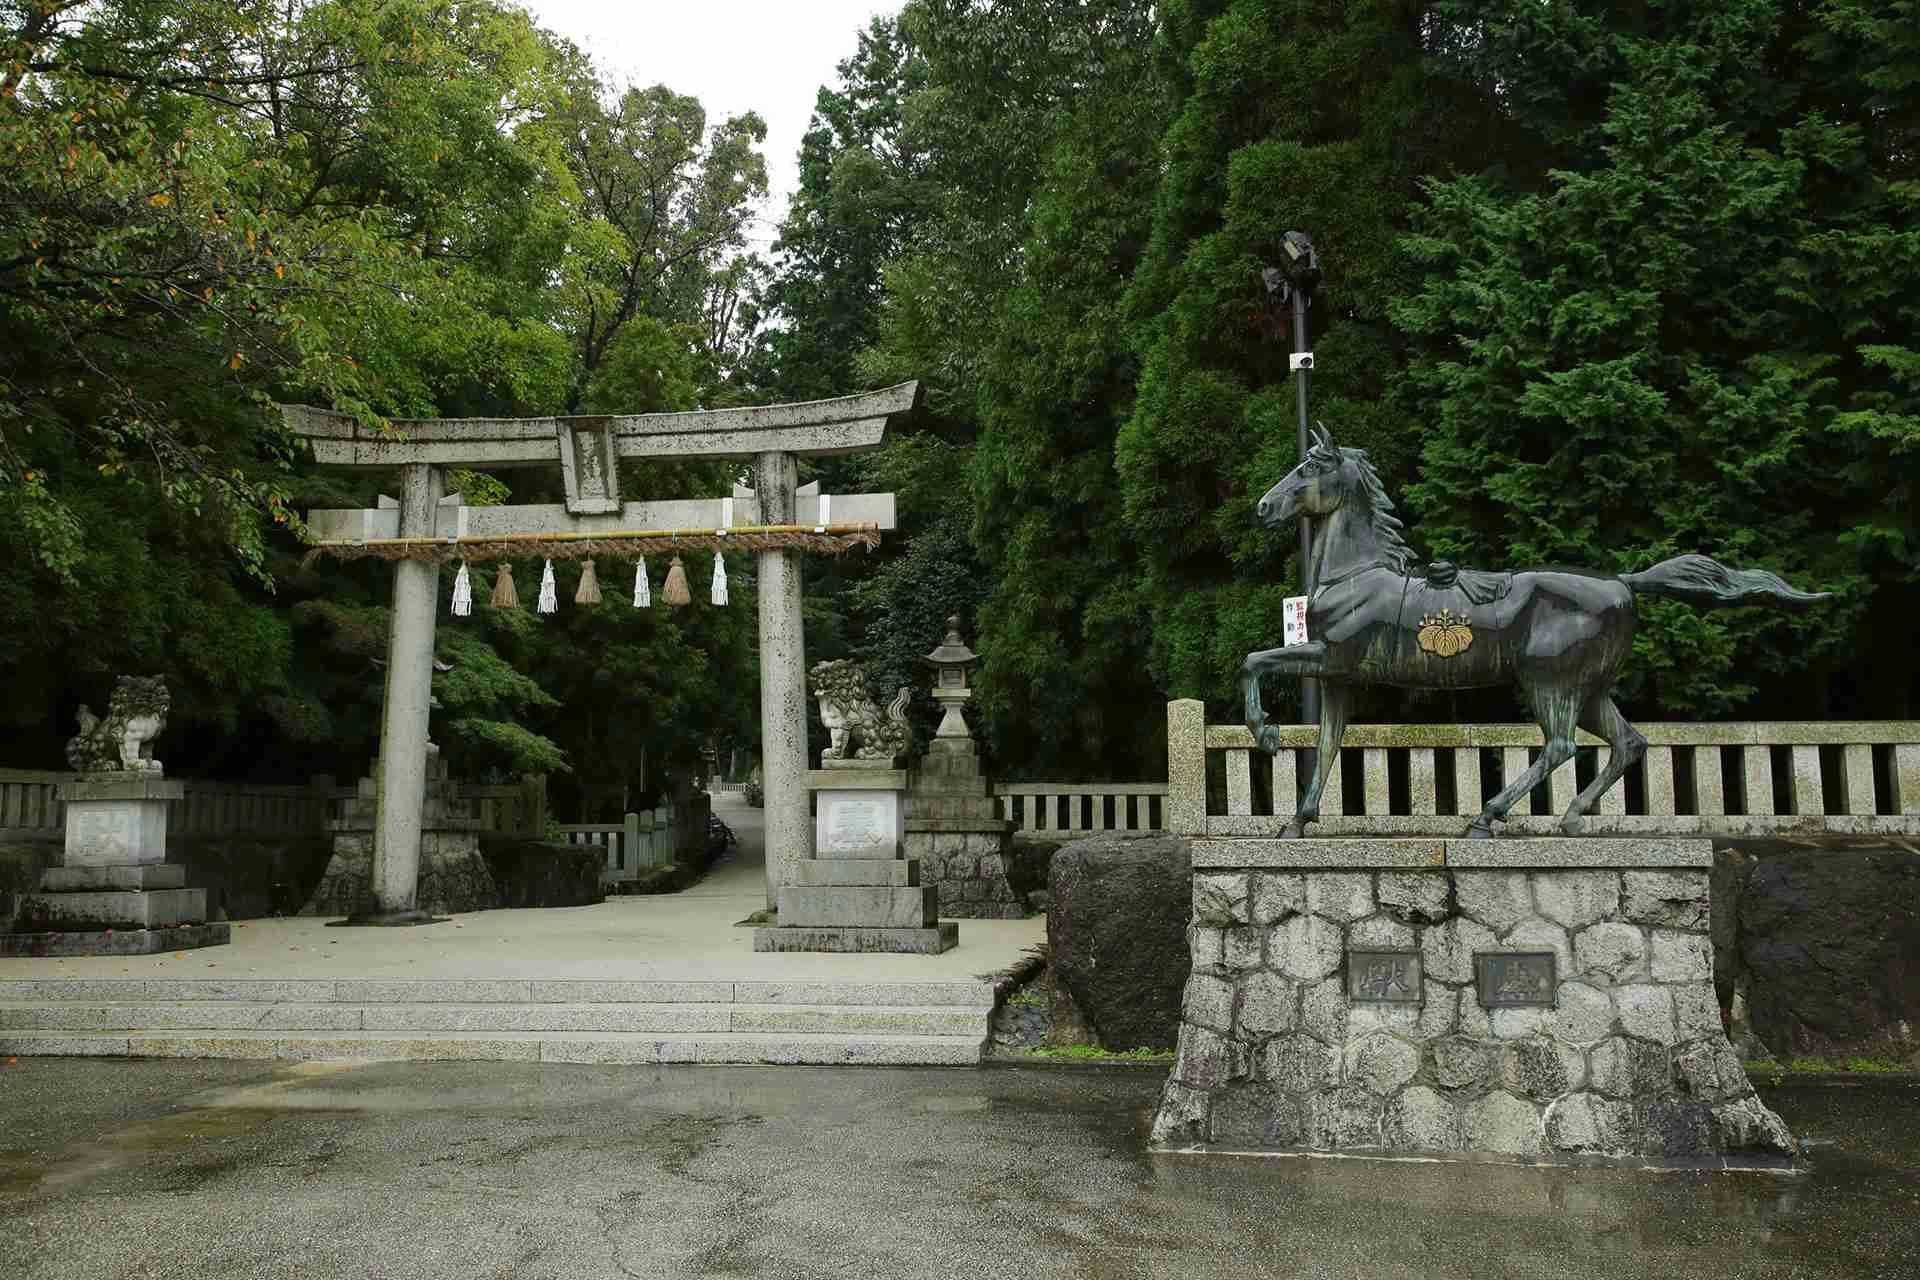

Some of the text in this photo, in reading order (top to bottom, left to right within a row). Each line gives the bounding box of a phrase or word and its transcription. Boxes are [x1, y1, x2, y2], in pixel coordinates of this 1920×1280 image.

[1286, 602, 1295, 643] 作動
[1295, 601, 1305, 644] 監視カメ
